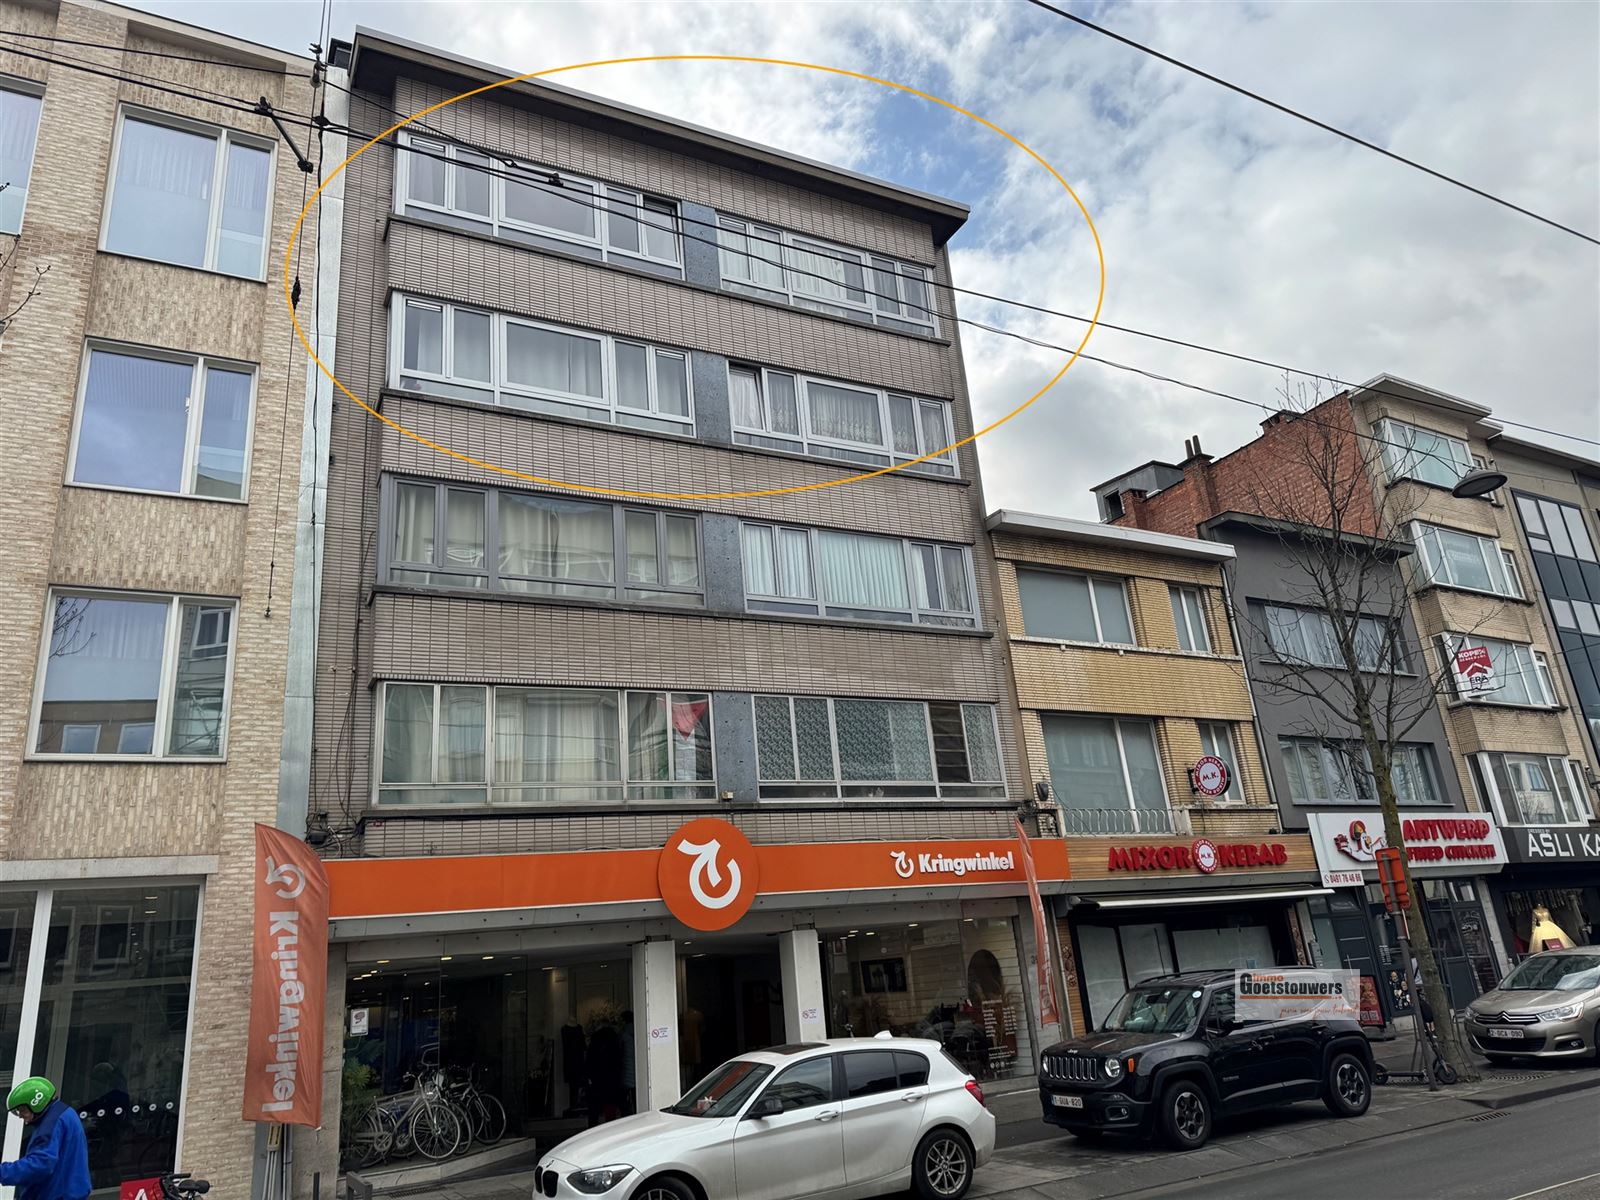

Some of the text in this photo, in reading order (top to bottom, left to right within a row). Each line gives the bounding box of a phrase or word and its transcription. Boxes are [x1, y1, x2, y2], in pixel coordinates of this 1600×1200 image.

[1470, 675, 1489, 683] ERA
[1402, 819, 1491, 842] ANTWERP
[1444, 844, 1497, 861] CHICKEN
[1528, 833, 1575, 857] ASLI
[918, 851, 1015, 876] Kringwinkel
[1109, 846, 1192, 872] MIXOR
[1218, 843, 1288, 868] KEBAB
